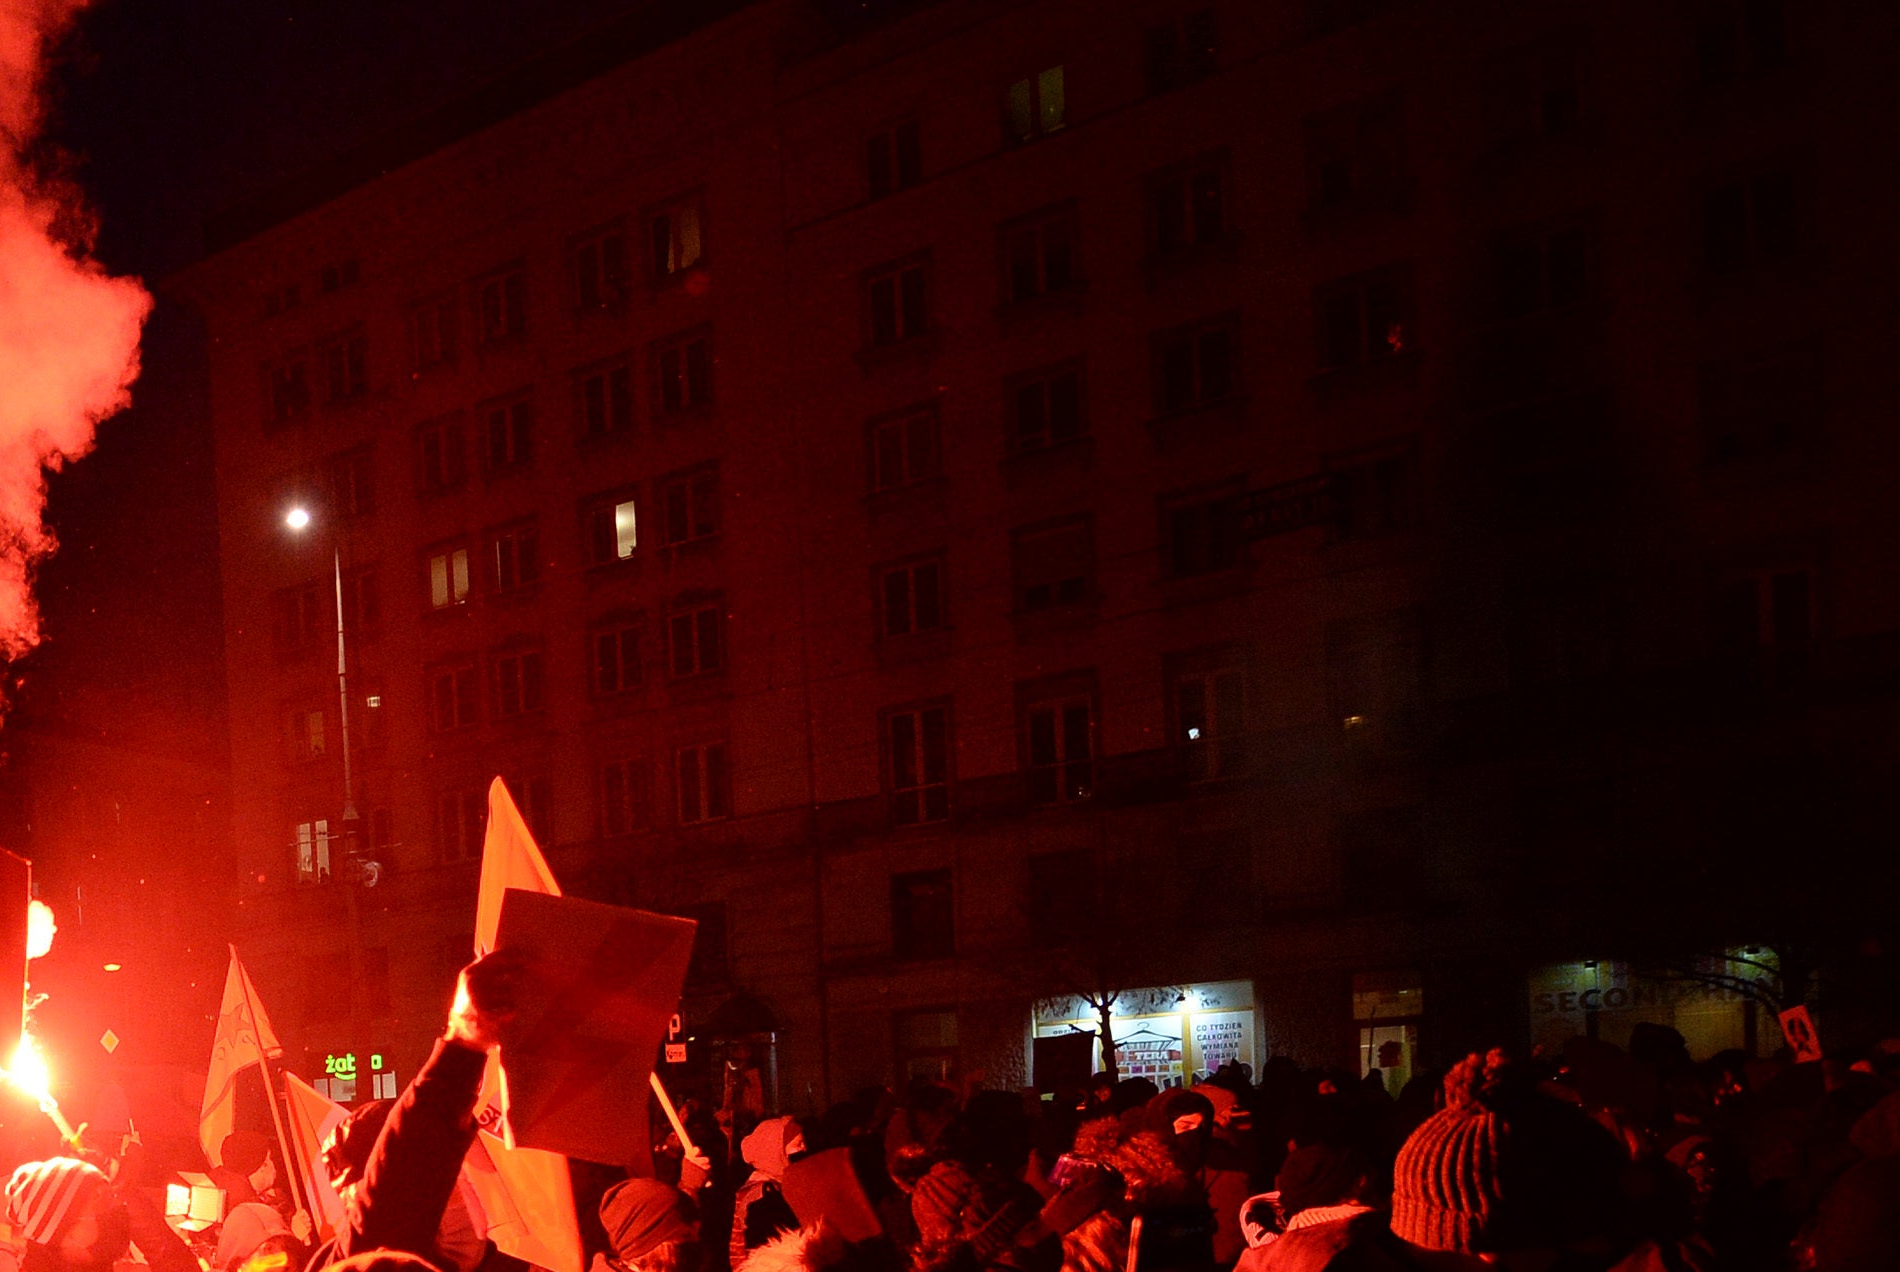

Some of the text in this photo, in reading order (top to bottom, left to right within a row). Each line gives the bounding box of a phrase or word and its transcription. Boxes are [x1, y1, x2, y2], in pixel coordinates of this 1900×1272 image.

[668, 1012, 682, 1042] P
[1196, 1024, 1208, 1032] CO
[325, 1053, 383, 1074] żaba
